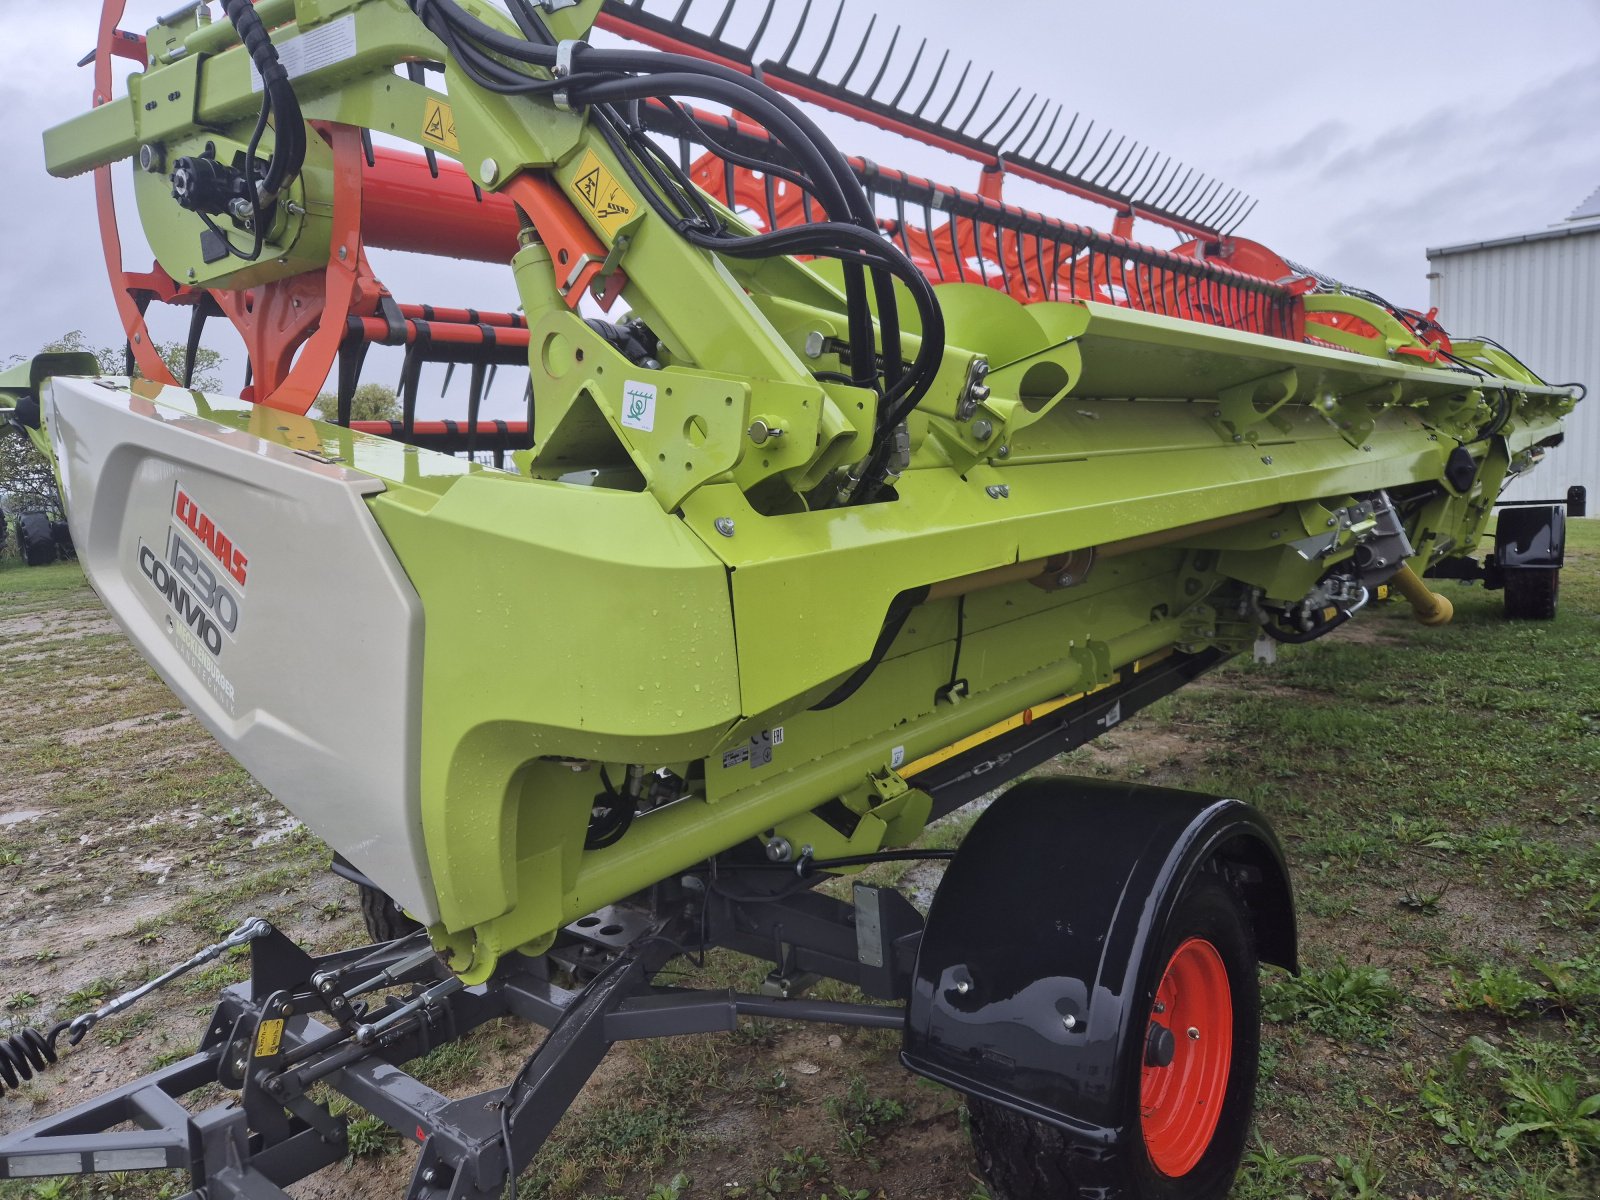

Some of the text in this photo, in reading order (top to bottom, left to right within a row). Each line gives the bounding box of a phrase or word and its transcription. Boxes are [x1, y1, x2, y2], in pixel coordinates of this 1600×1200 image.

[169, 533, 238, 633] 1230
[175, 490, 248, 587] CLAAS
[139, 545, 222, 656] CONVIO
[175, 619, 236, 703] MECKLENBURGER
